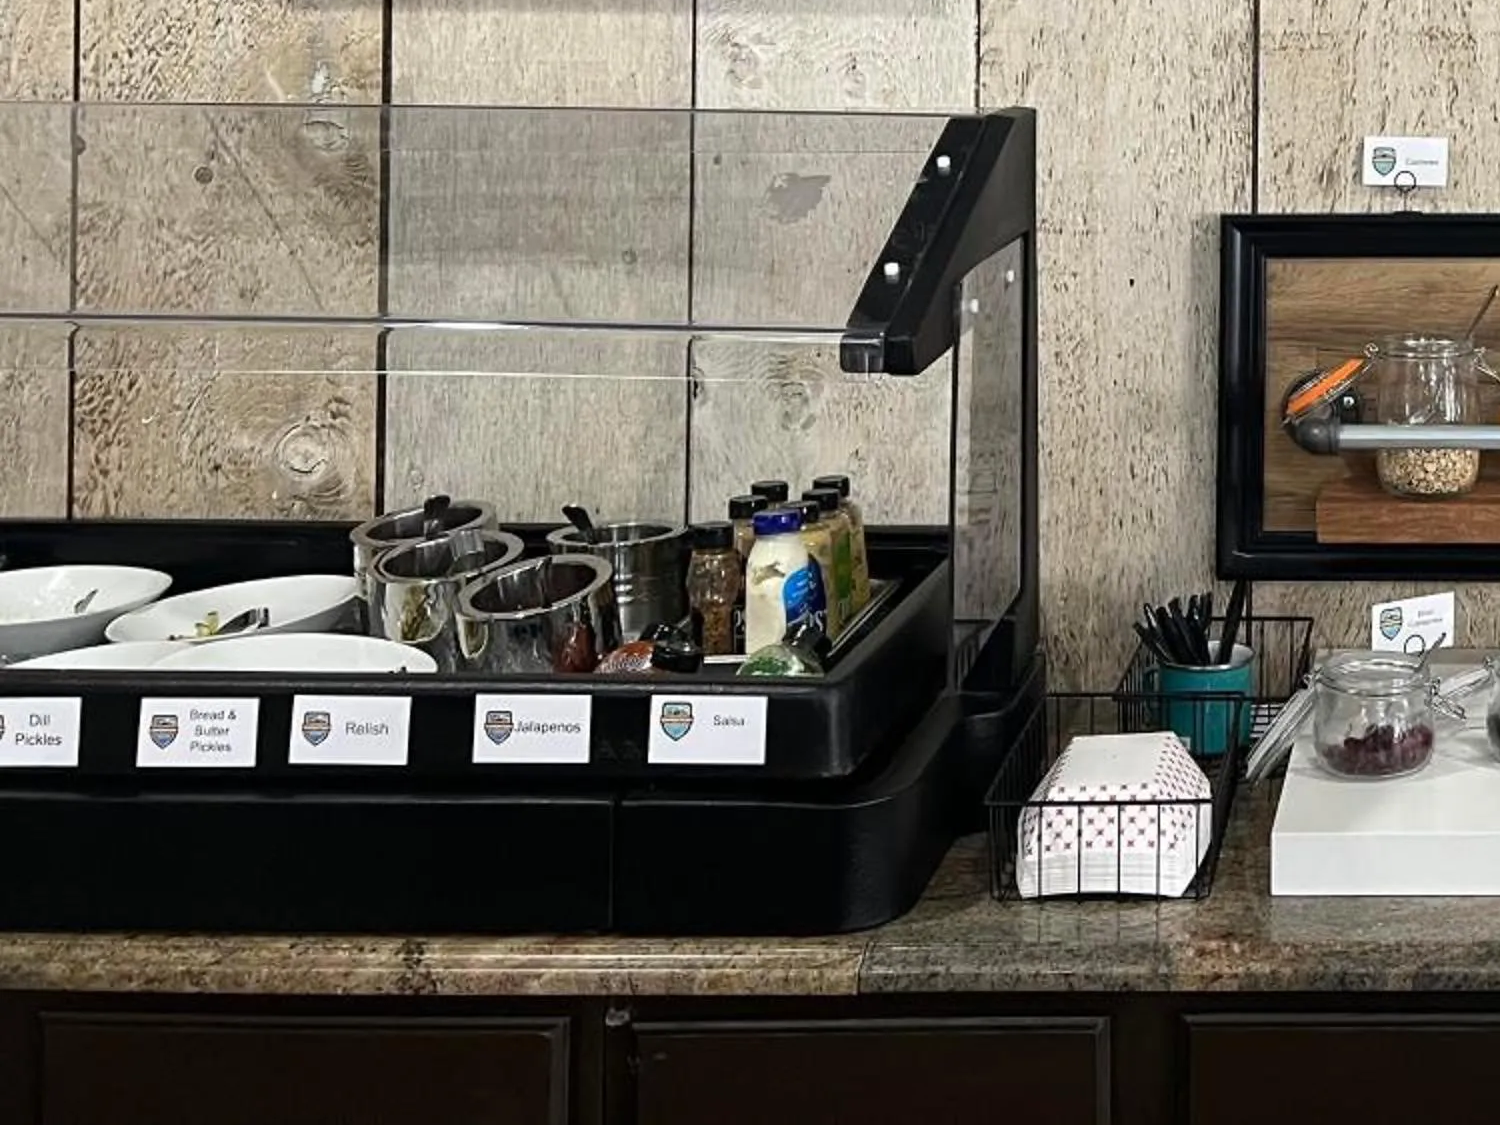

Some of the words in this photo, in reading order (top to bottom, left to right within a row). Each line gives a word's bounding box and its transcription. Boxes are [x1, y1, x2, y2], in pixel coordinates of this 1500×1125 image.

[29, 713, 51, 727] Dill
[190, 709, 224, 721] Bread
[227, 710, 237, 721] &
[194, 725, 230, 737] Butter
[345, 722, 389, 736] Relish
[15, 733, 62, 747] Pickles
[190, 741, 232, 753] Pickles
